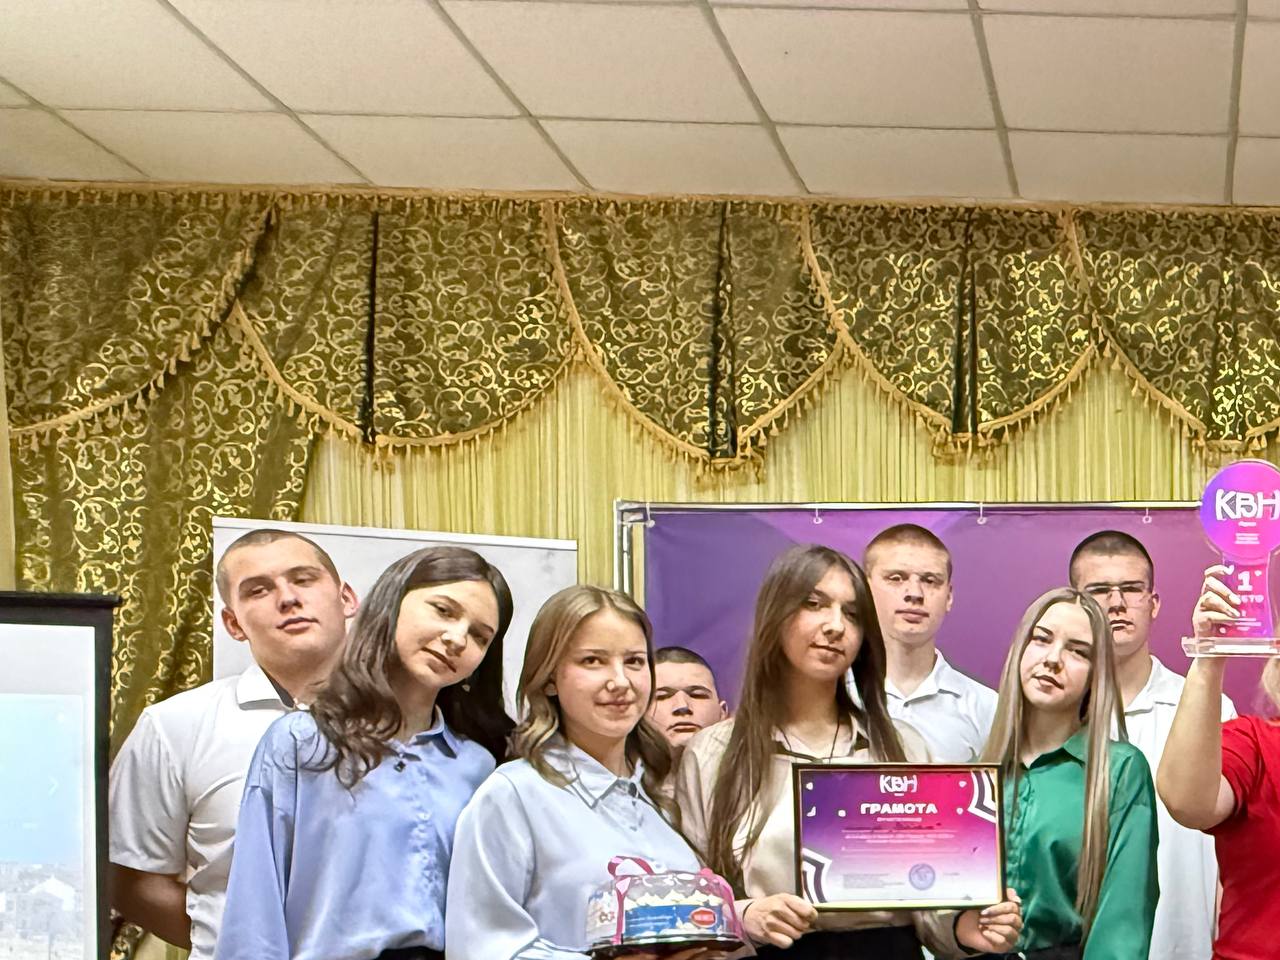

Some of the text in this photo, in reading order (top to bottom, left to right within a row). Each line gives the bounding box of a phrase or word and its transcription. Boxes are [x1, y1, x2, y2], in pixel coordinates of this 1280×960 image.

[1215, 489, 1280, 521] КВН
[1238, 571, 1253, 591] 1
[880, 775, 917, 793] КВН
[860, 803, 938, 814] ГРАМОТА
